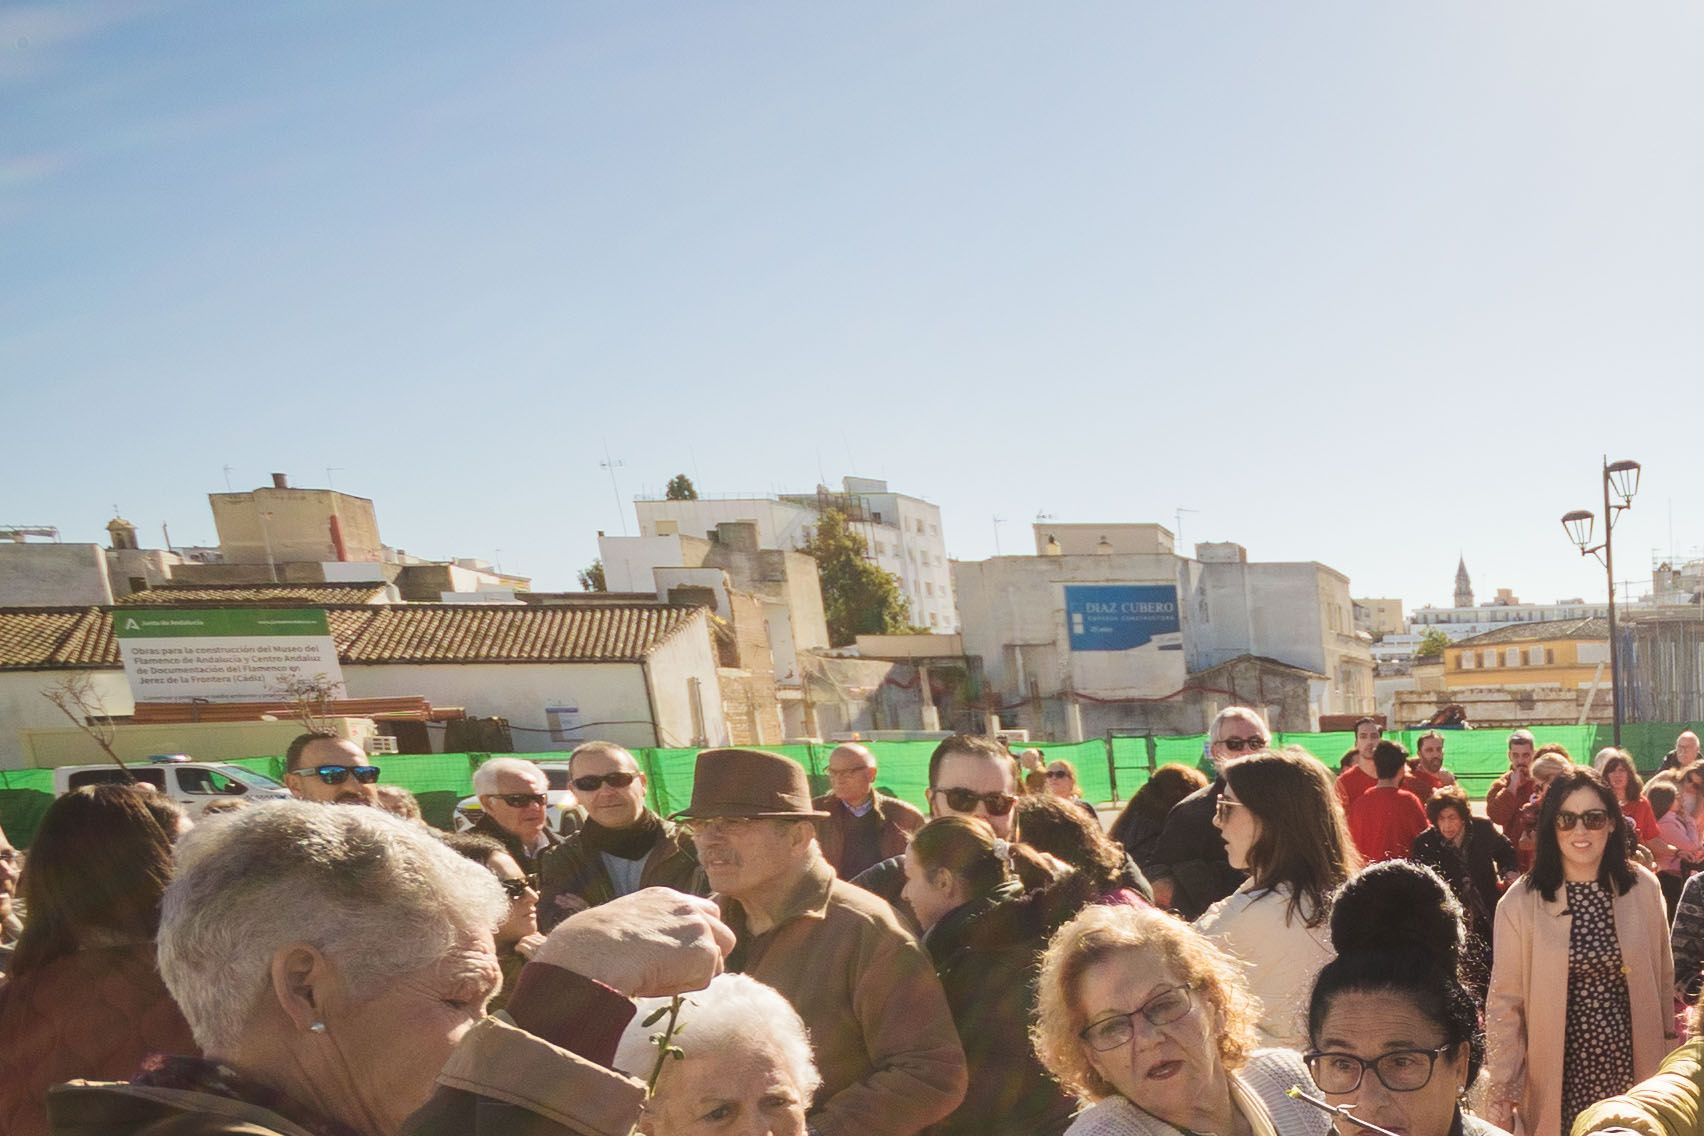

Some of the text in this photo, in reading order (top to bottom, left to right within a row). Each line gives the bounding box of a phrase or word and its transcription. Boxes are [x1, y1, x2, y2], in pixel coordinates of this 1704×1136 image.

[1086, 602, 1173, 613] DIAZ CUBERO
[131, 647, 161, 655] Obras
[162, 648, 183, 656] para
[195, 645, 256, 654] construcción
[256, 645, 271, 653] del
[134, 657, 181, 665] Flamenco
[251, 655, 283, 663] Centro
[150, 666, 225, 674] Documentación
[140, 677, 164, 685] Jerez
[191, 675, 232, 683] Frontera
